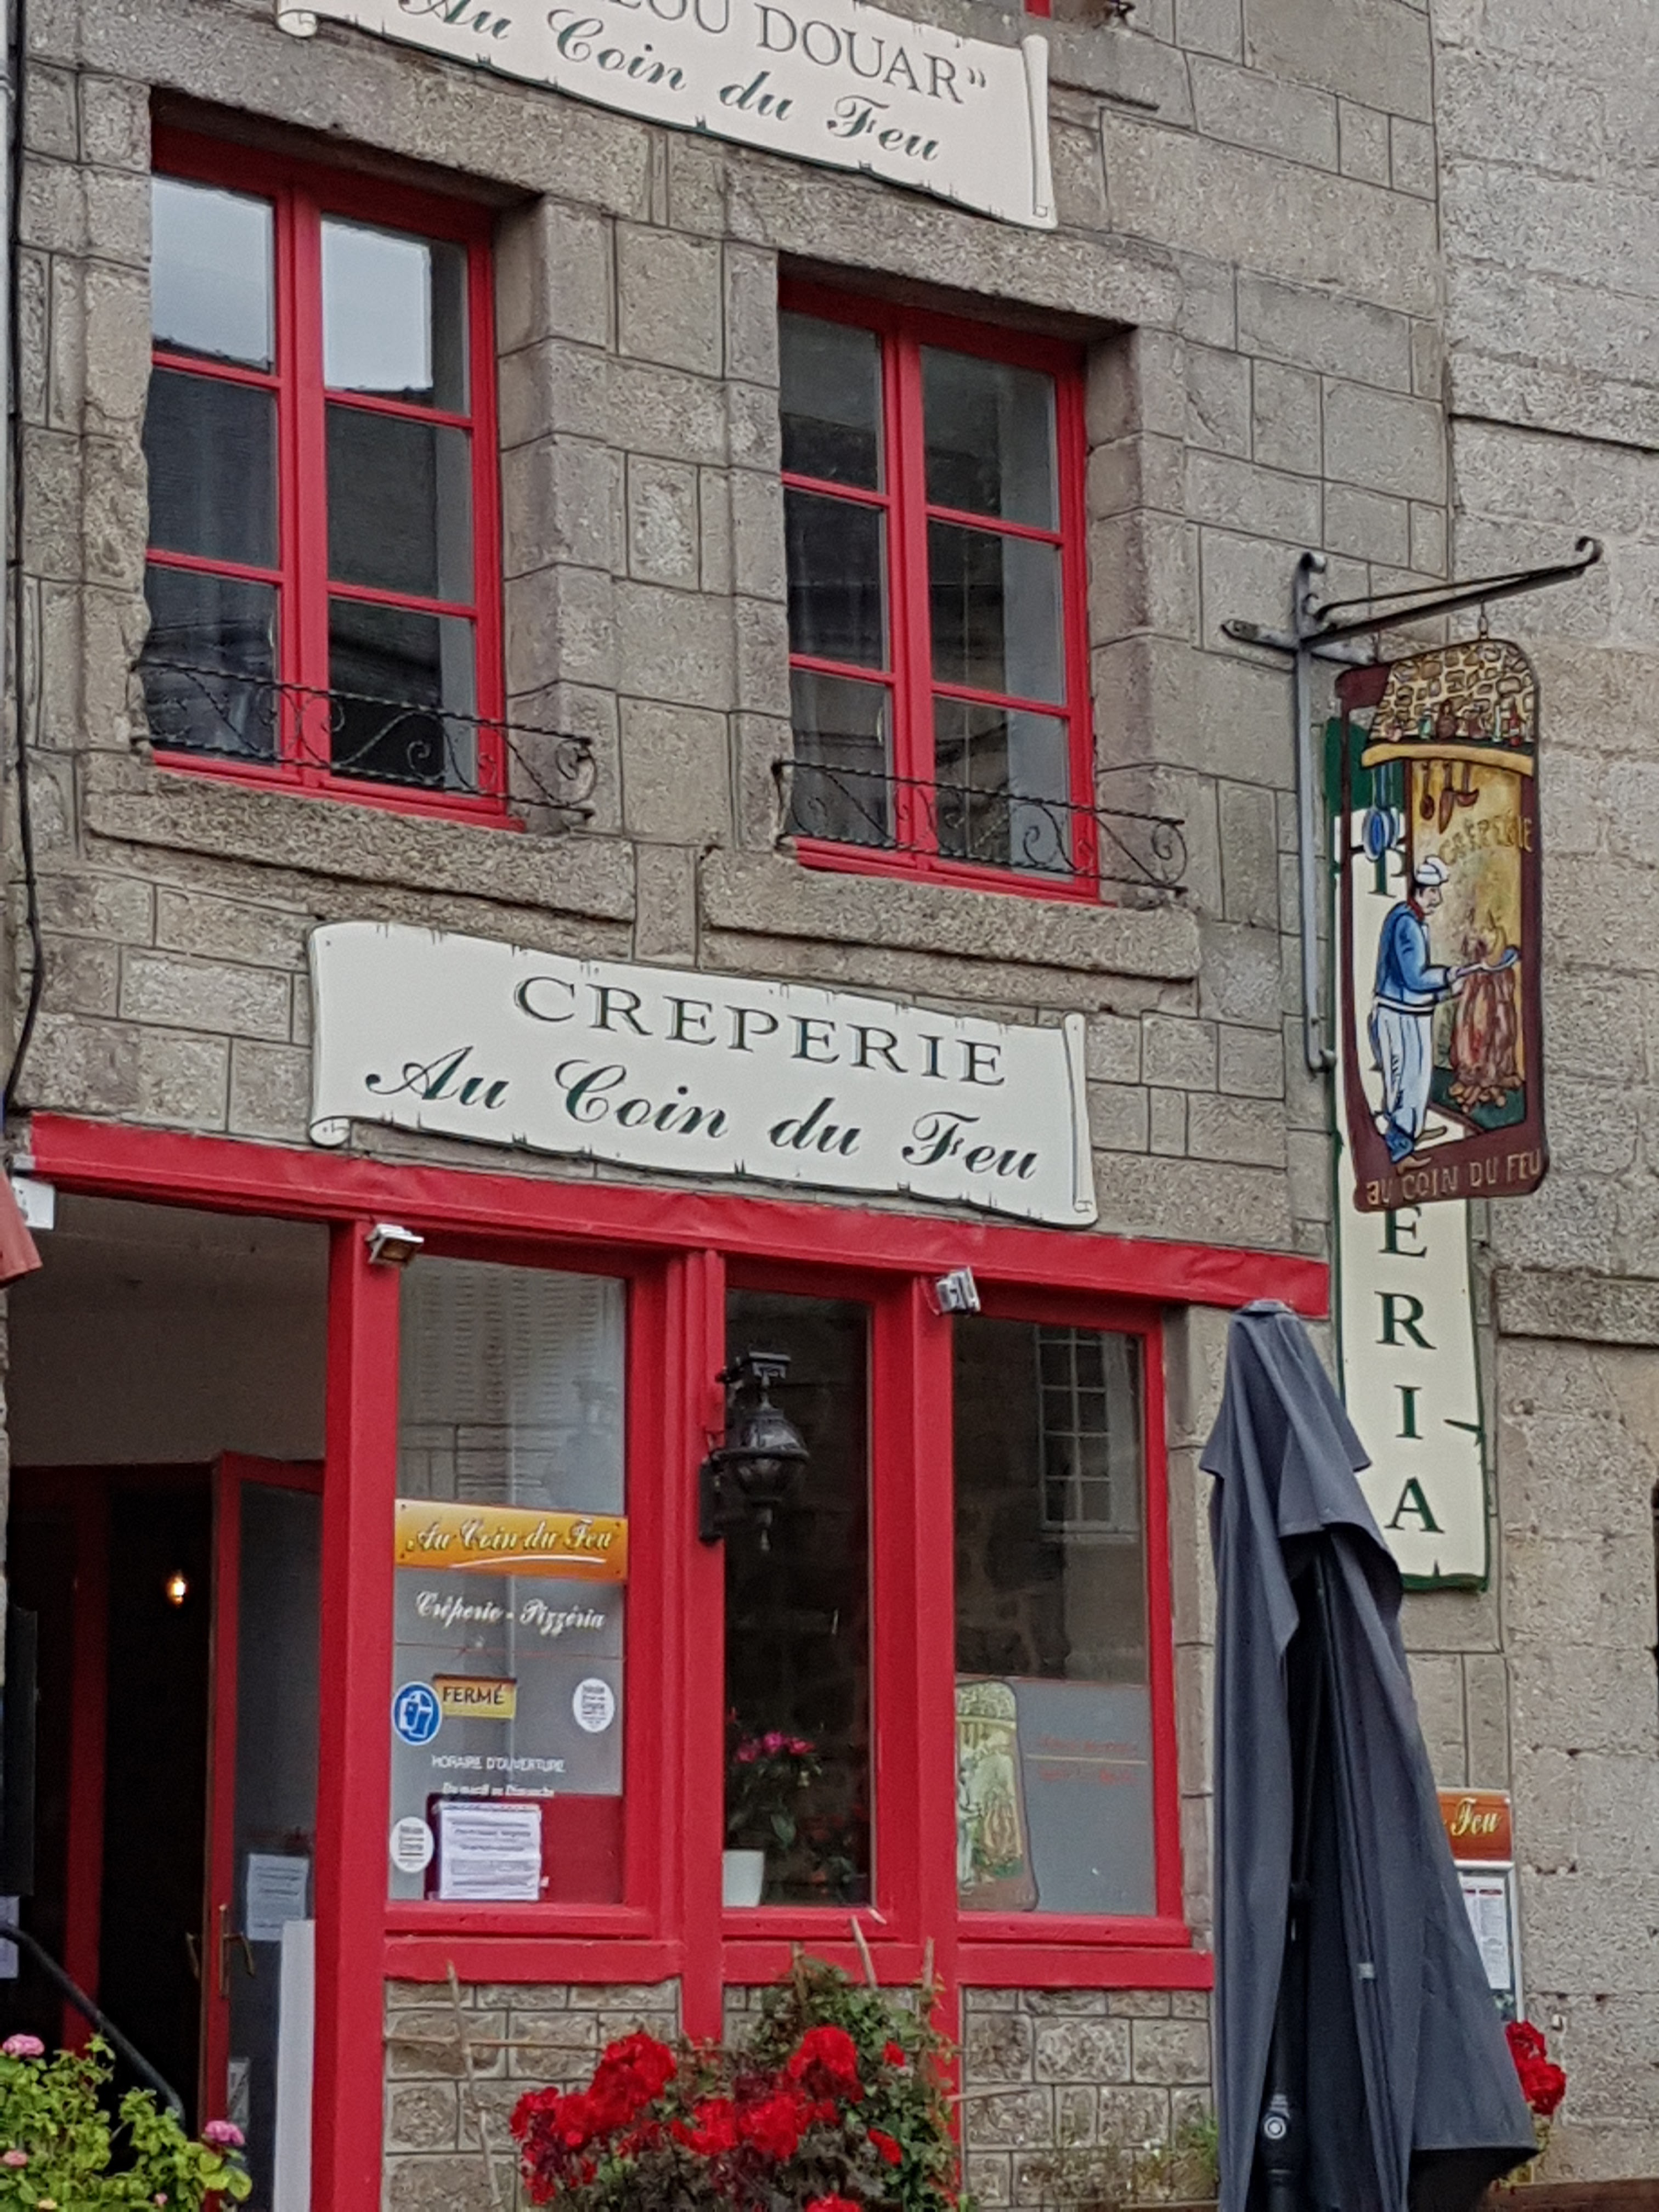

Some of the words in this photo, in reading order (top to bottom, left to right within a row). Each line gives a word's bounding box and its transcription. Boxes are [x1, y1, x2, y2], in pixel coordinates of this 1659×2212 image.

[548, 9, 686, 91] Coin
[719, 71, 793, 121] du
[827, 95, 939, 161] Feu
[514, 977, 1006, 1086] CREPERIE
[365, 1046, 509, 1109] Au
[555, 1059, 728, 1138] Coin
[769, 1097, 861, 1155] du
[902, 1111, 1038, 1180] Feu
[1402, 1166, 1458, 1200] COIN
[1470, 1157, 1498, 1187] DU
[1507, 1149, 1542, 1182] FEU
[460, 1517, 518, 1549] Coin
[523, 1520, 556, 1549] du
[564, 1518, 611, 1549] Feu
[443, 1684, 505, 1705] FERMÉ
[1451, 1797, 1500, 1836] Feu
